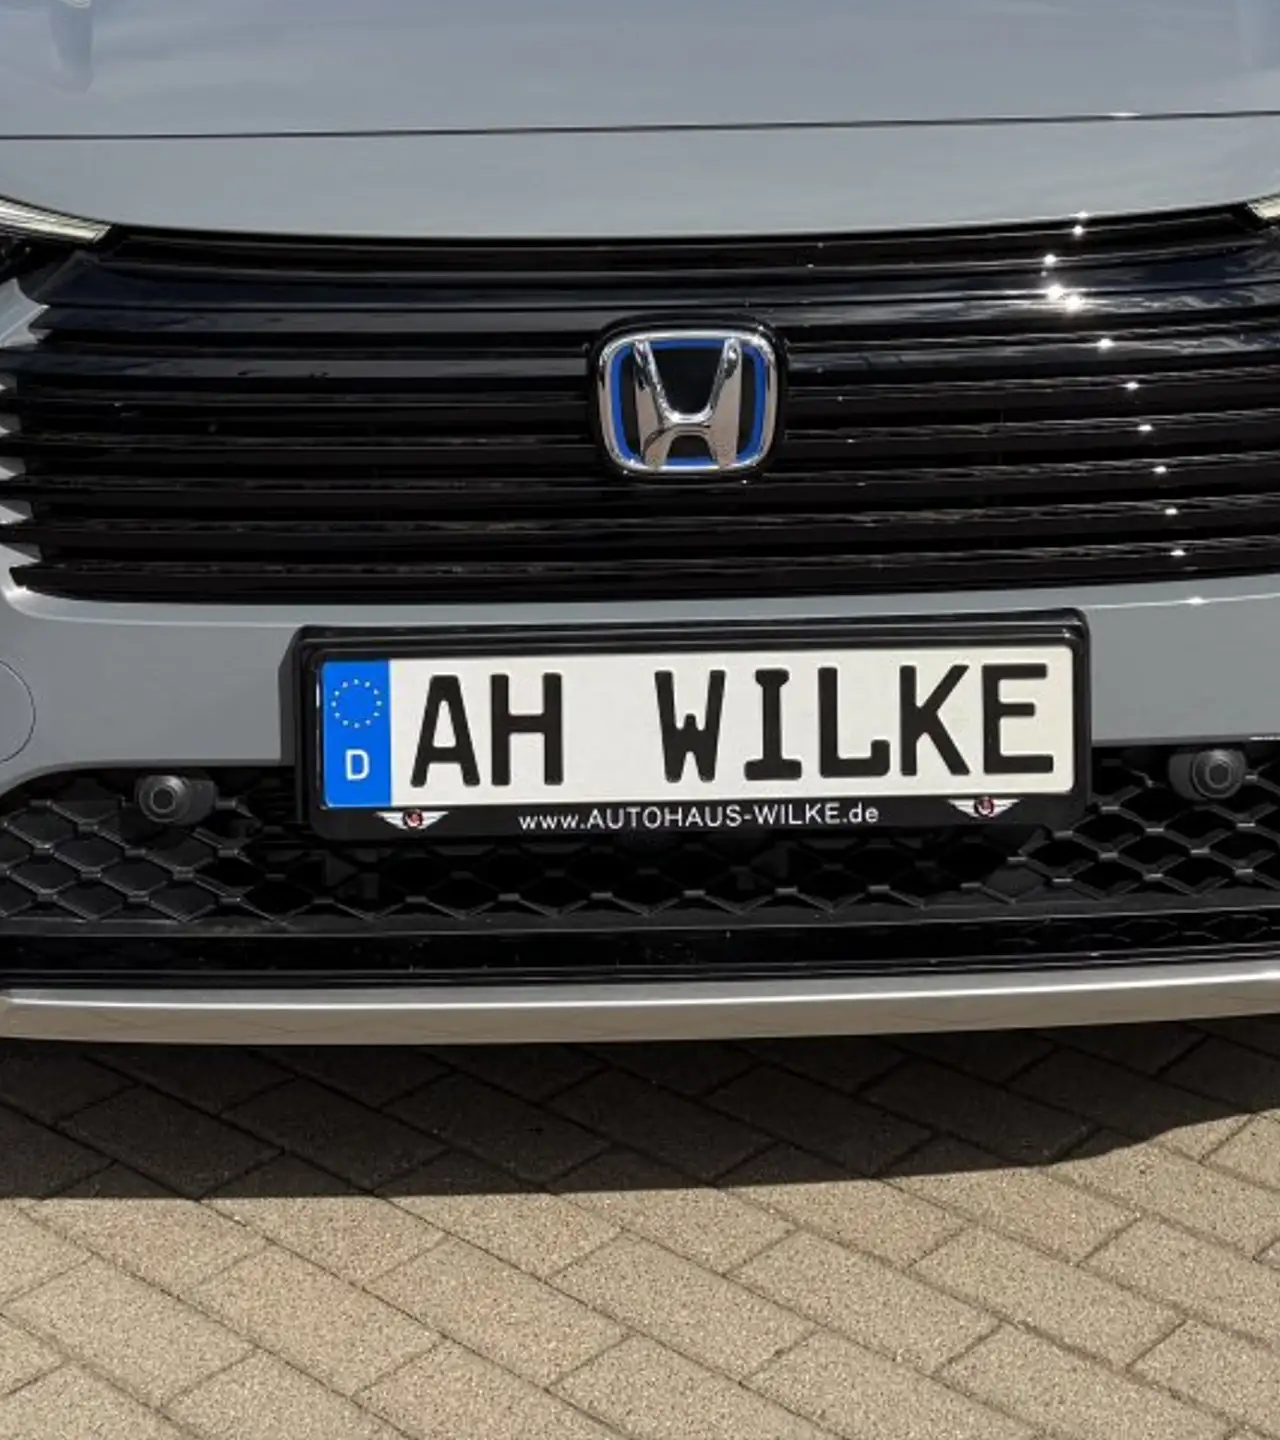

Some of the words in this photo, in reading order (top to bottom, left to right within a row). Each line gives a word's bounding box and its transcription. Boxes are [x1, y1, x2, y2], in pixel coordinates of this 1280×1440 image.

[411, 673, 563, 788] AH
[654, 664, 1054, 783] WILKE
[346, 749, 370, 780] D
[518, 801, 880, 831] www.AUTOHAUS-WILKE.de
